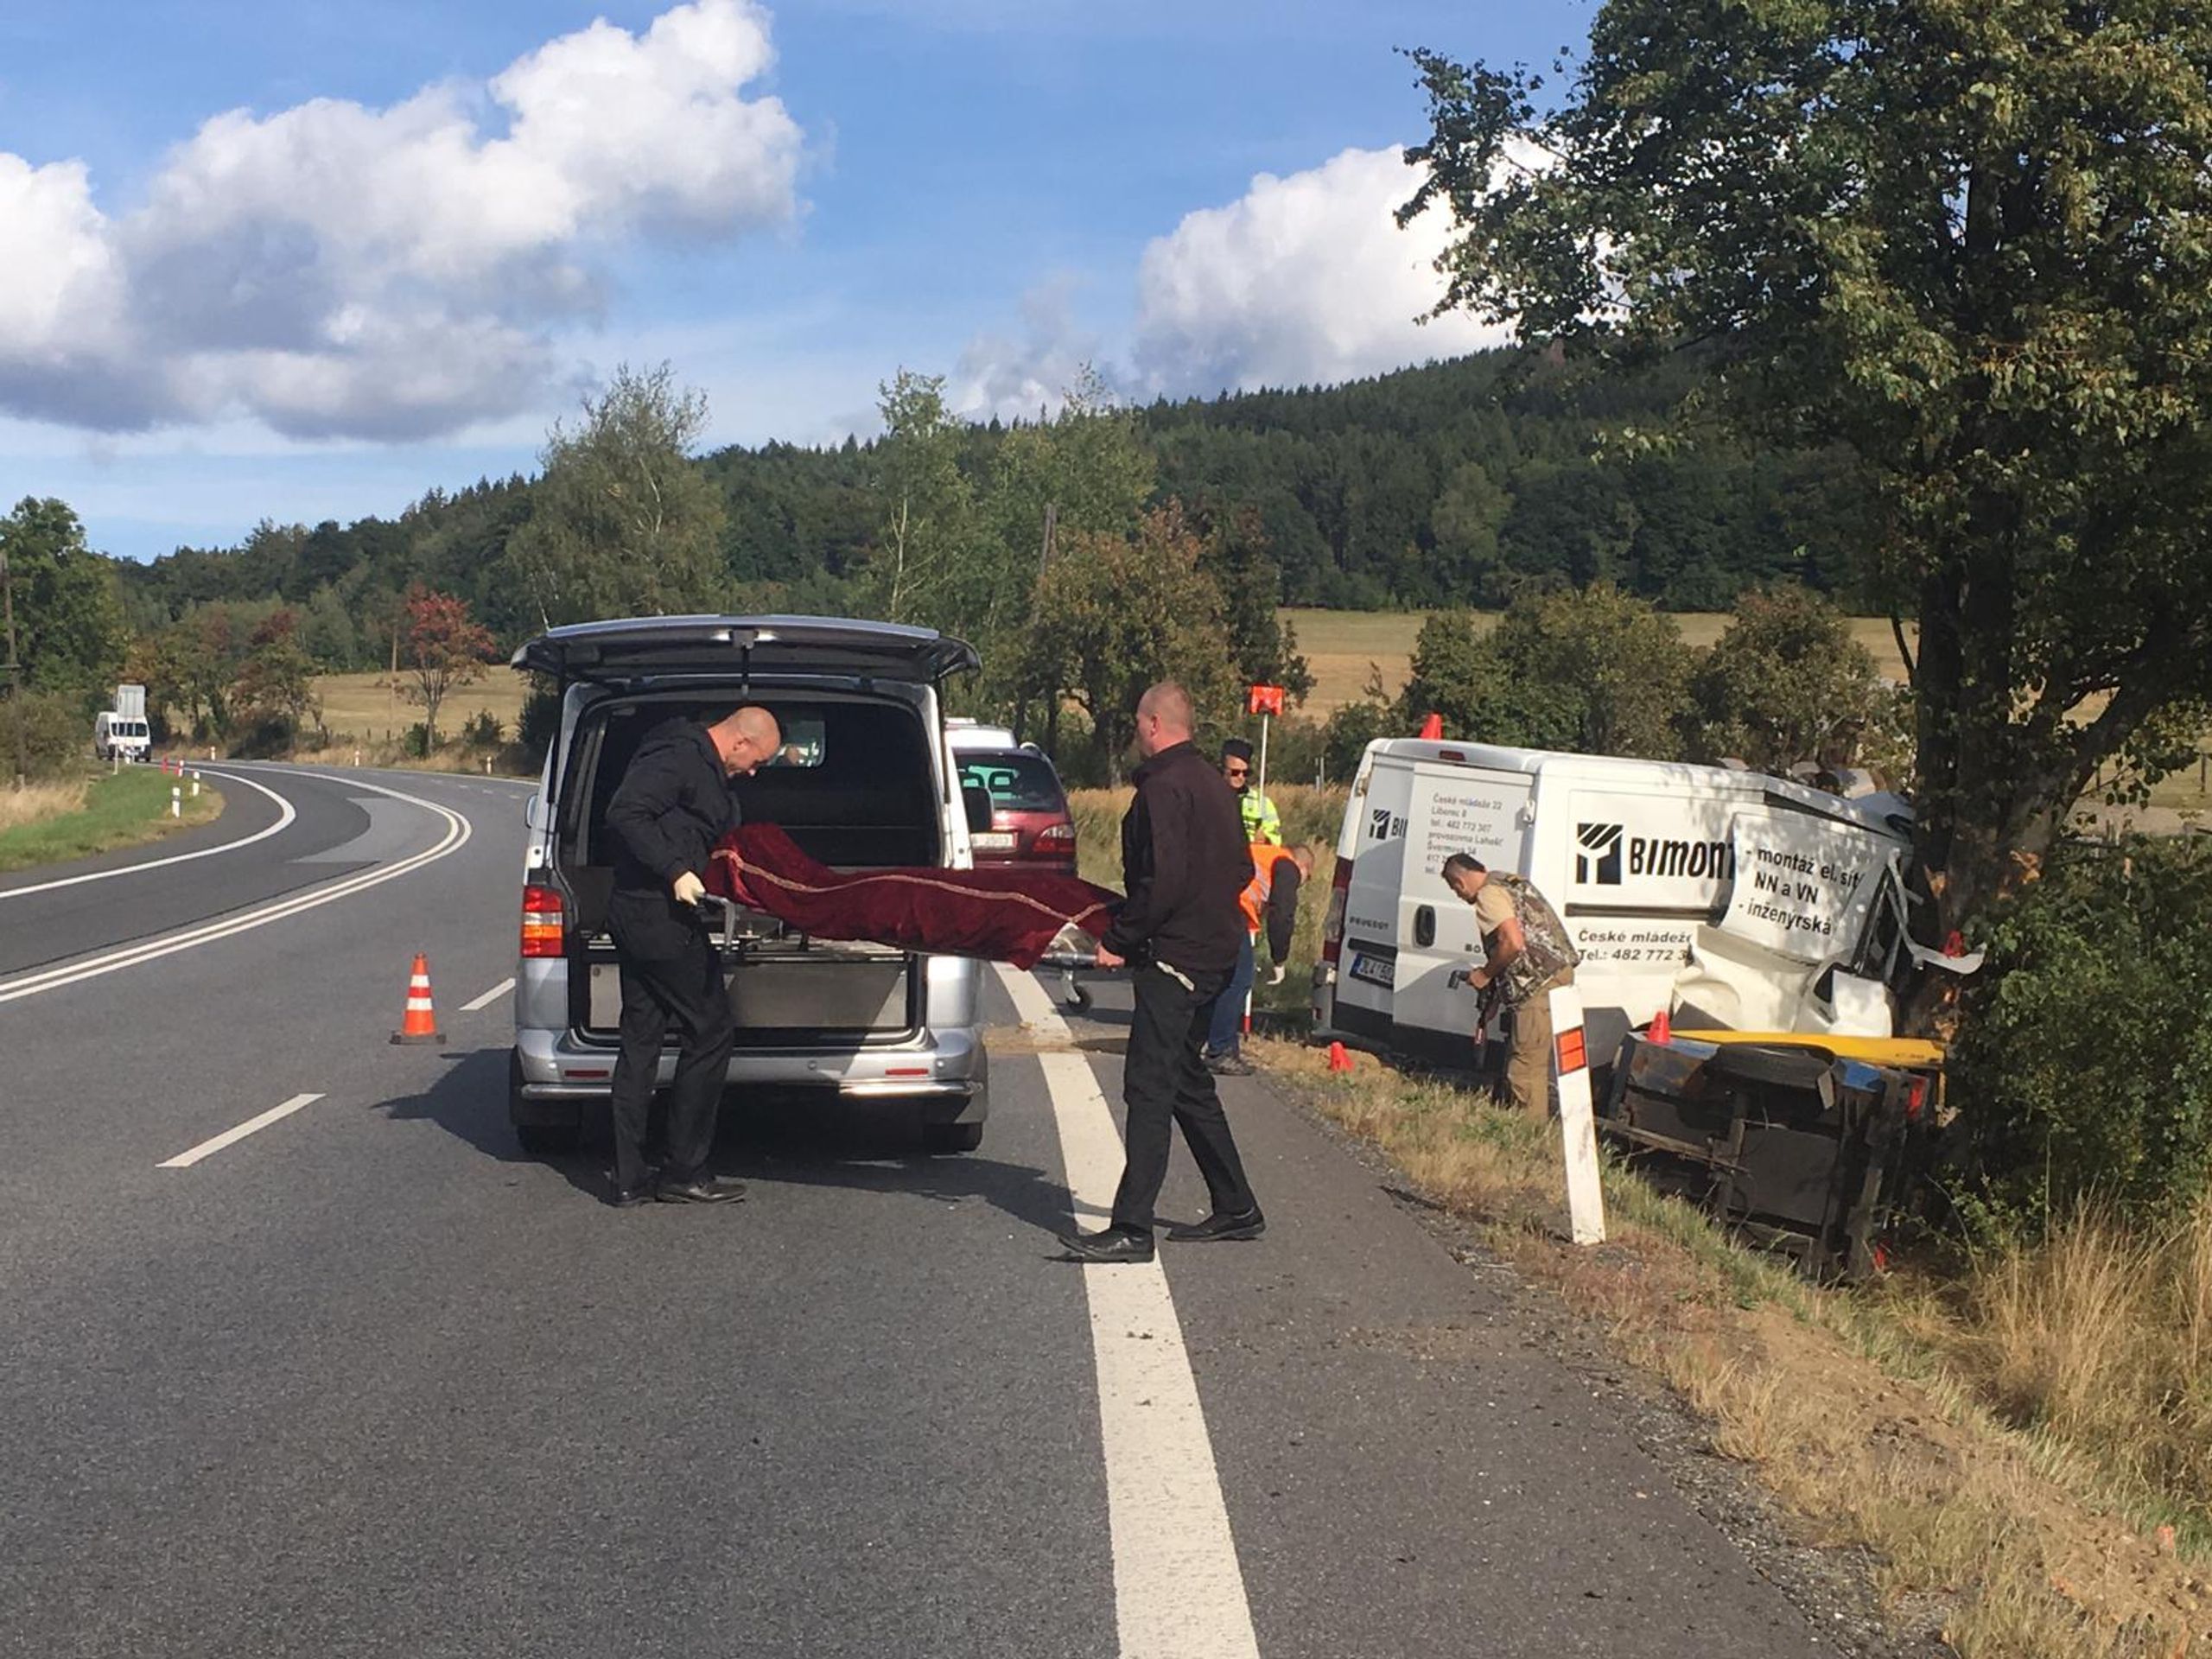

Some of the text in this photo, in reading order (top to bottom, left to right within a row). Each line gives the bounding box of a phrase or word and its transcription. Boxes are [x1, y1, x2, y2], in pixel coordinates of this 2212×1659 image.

[1758, 849, 1815, 874] montáž
[1754, 872, 1819, 905] NN a VN
[1349, 916, 1389, 931] PEUGEOT
[1578, 928, 1626, 943] České
[1465, 944, 1482, 954] BO
[1611, 949, 1641, 961] 482
[1646, 950, 1673, 961] 772
